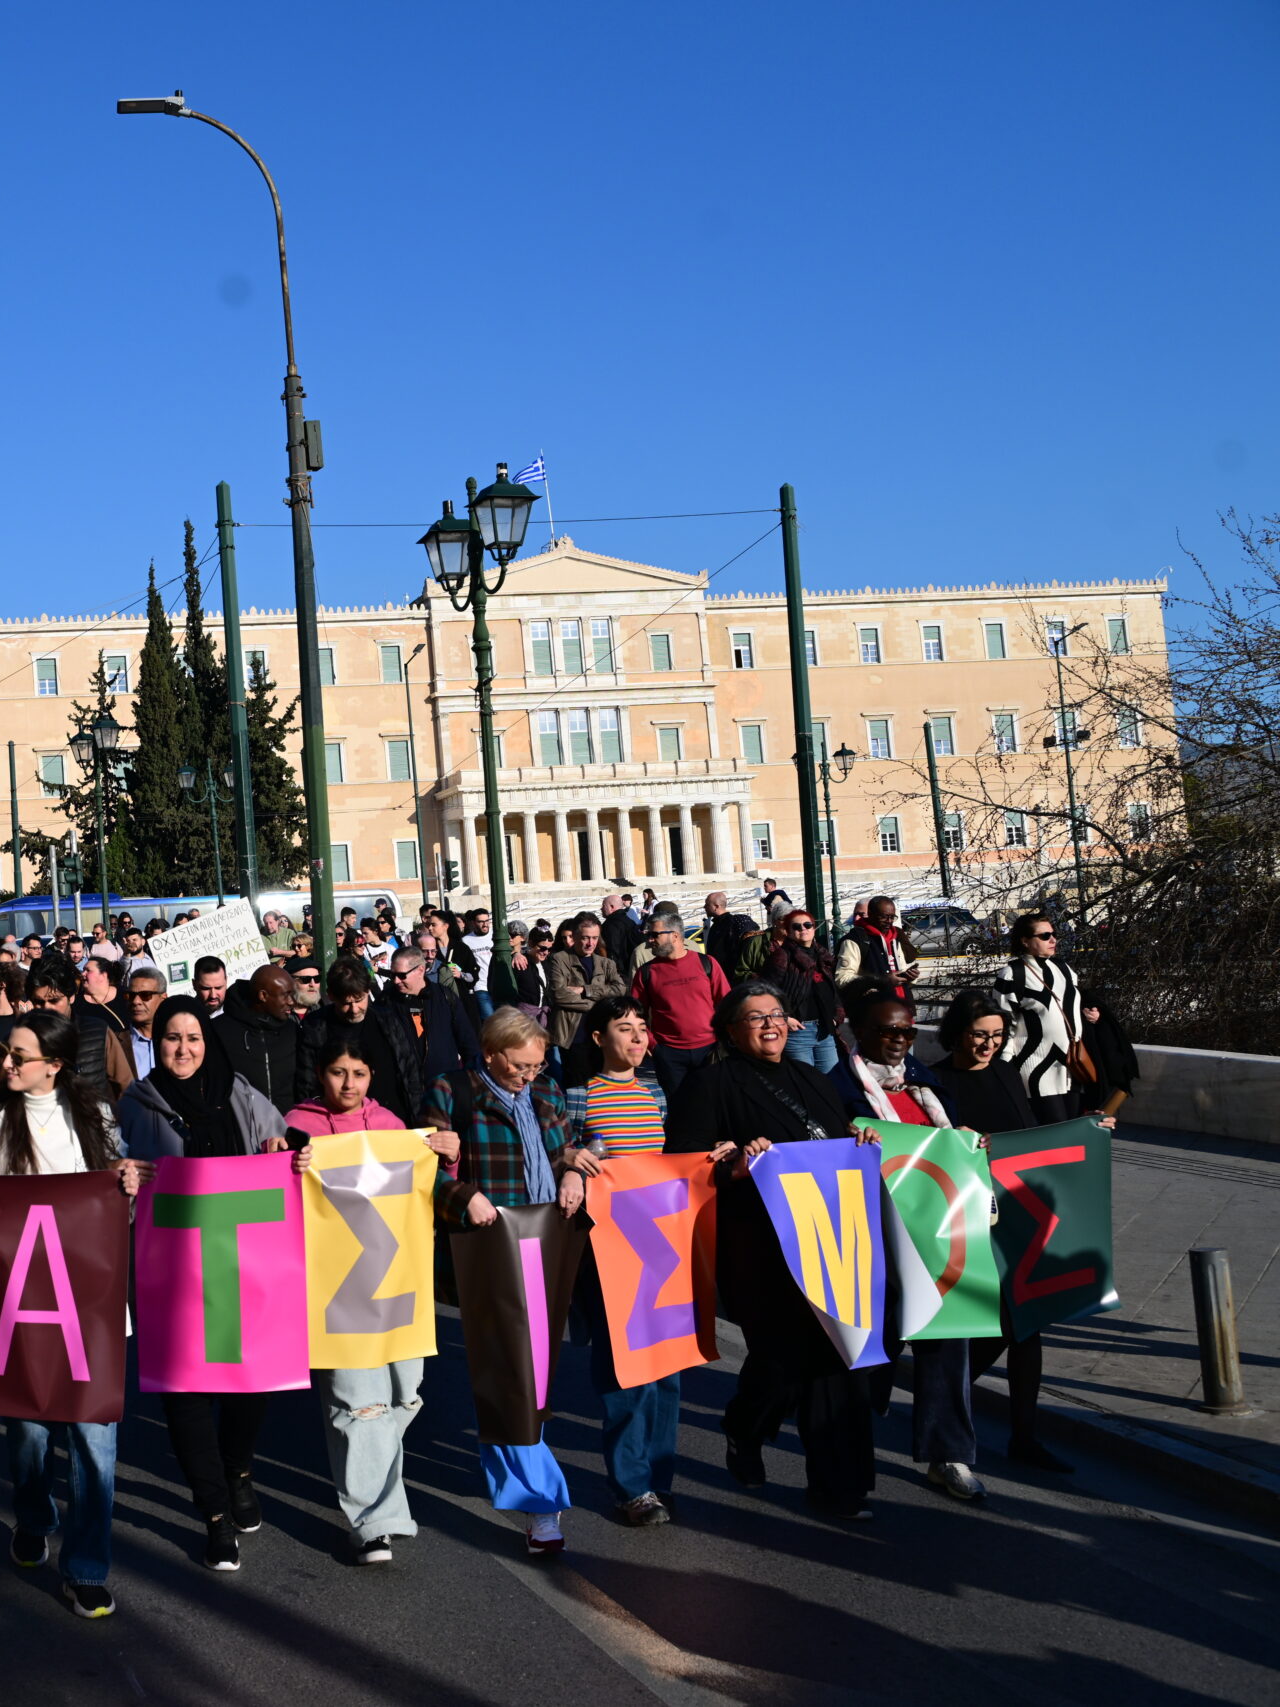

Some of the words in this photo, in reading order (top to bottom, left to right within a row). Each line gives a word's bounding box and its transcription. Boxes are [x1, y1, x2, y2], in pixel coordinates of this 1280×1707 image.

[152, 932, 178, 951] ΟΧΙ
[157, 952, 170, 962] ΤΟ
[170, 940, 201, 954] ΣΤΙΓΜΑ
[203, 932, 216, 942] ΚΑΙ
[220, 925, 232, 935] ΤΑ
[191, 928, 250, 958] ΣΤΕΡΕΟΤΥΠΑ
